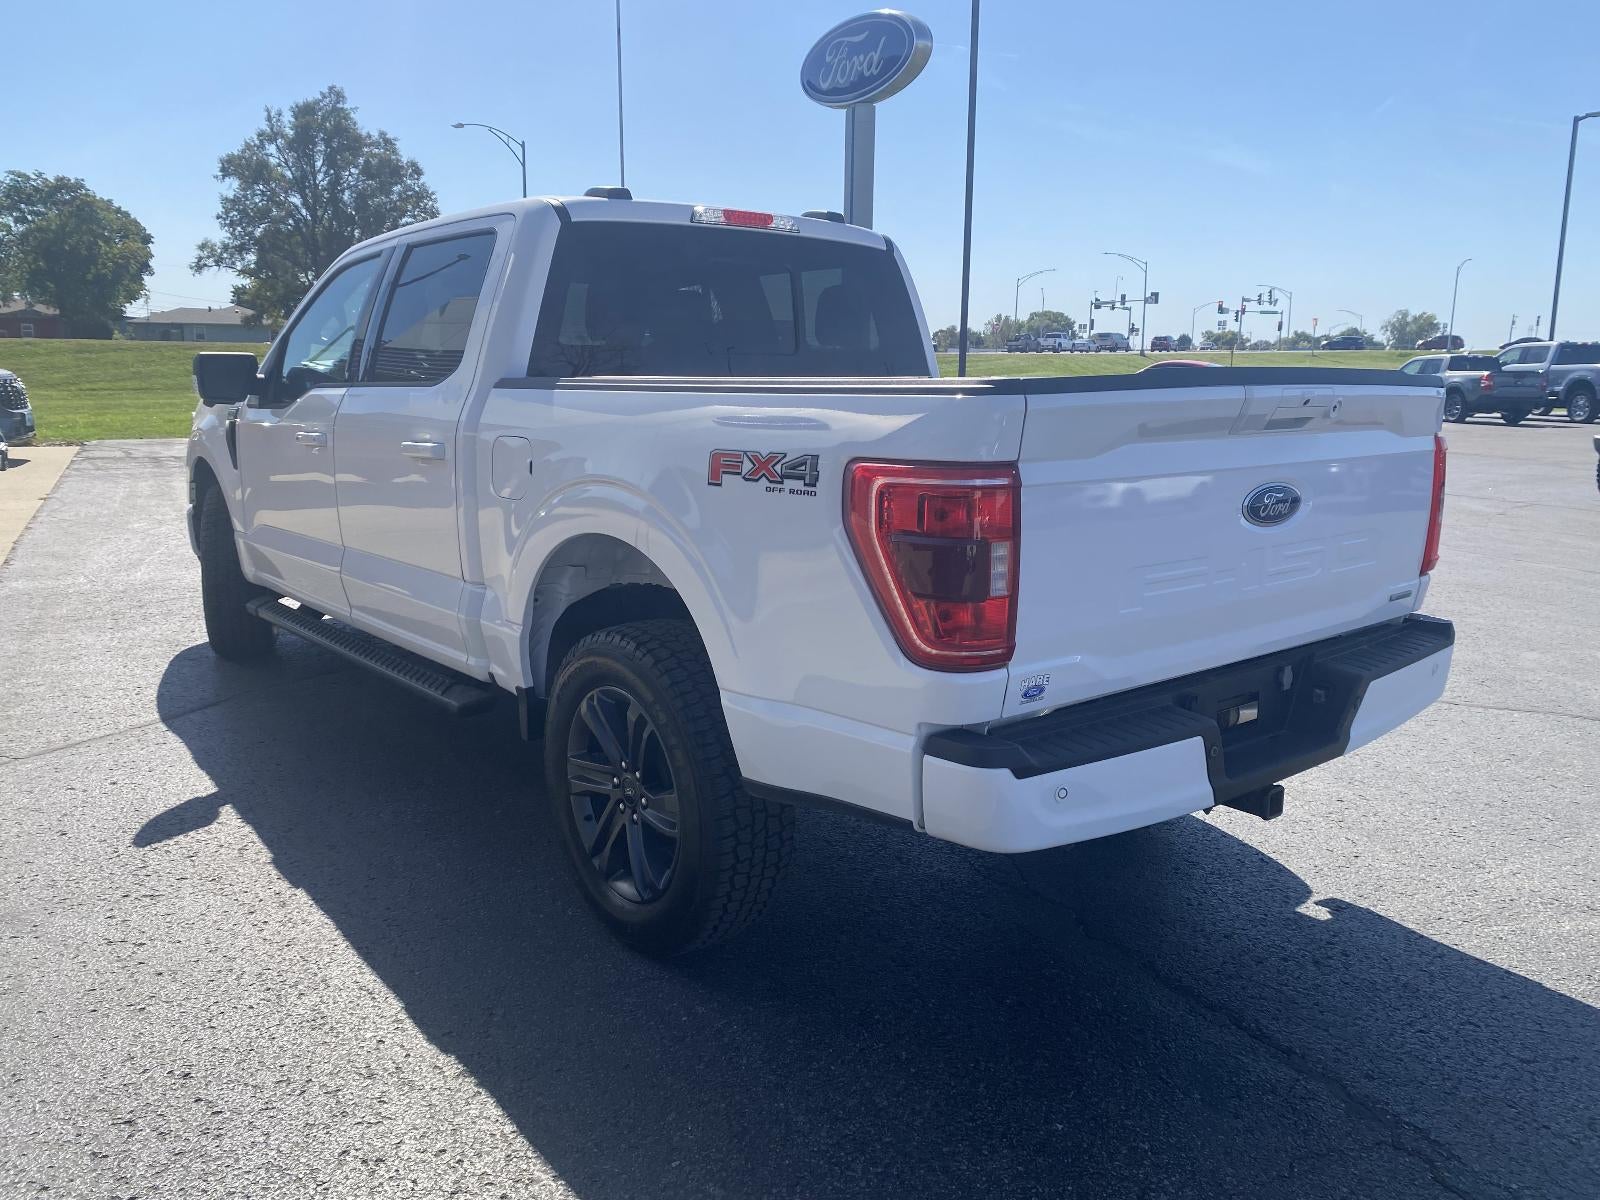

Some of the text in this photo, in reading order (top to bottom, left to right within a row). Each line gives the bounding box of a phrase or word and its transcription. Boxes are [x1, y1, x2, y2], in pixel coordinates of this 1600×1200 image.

[819, 30, 887, 91] Ford
[708, 448, 819, 487] FX4
[765, 486, 817, 497] OFF ROAD
[1260, 492, 1292, 517] Ford
[1020, 674, 1050, 691] HARE
